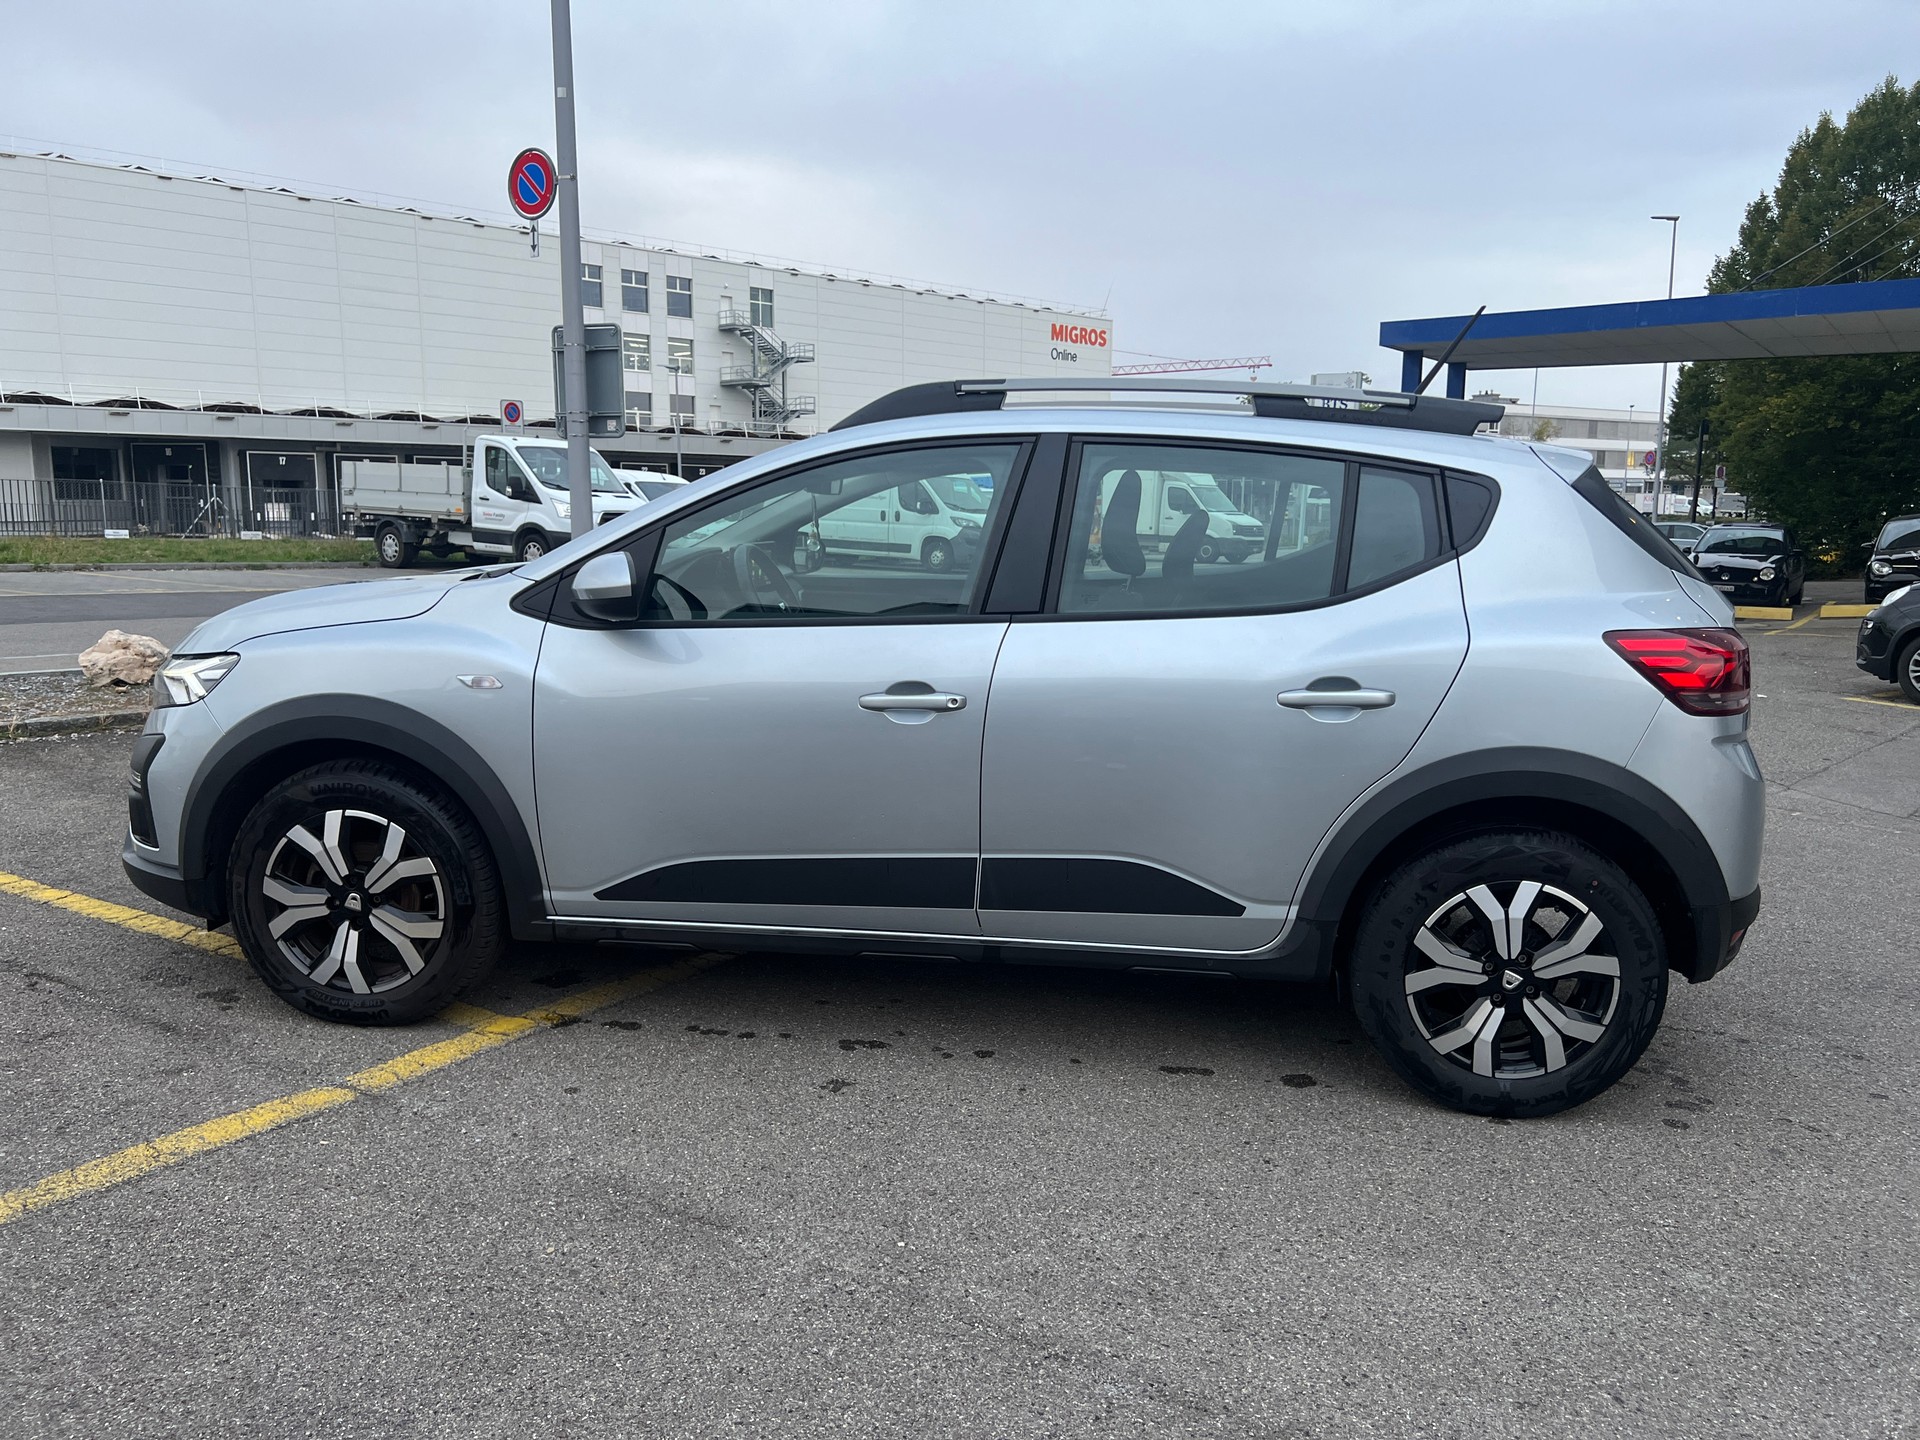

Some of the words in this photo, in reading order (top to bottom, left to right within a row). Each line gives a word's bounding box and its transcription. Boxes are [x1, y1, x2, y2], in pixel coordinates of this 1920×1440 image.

[1051, 323, 1107, 347] MIGROS
[1051, 347, 1078, 362] Online
[278, 456, 286, 465] 17
